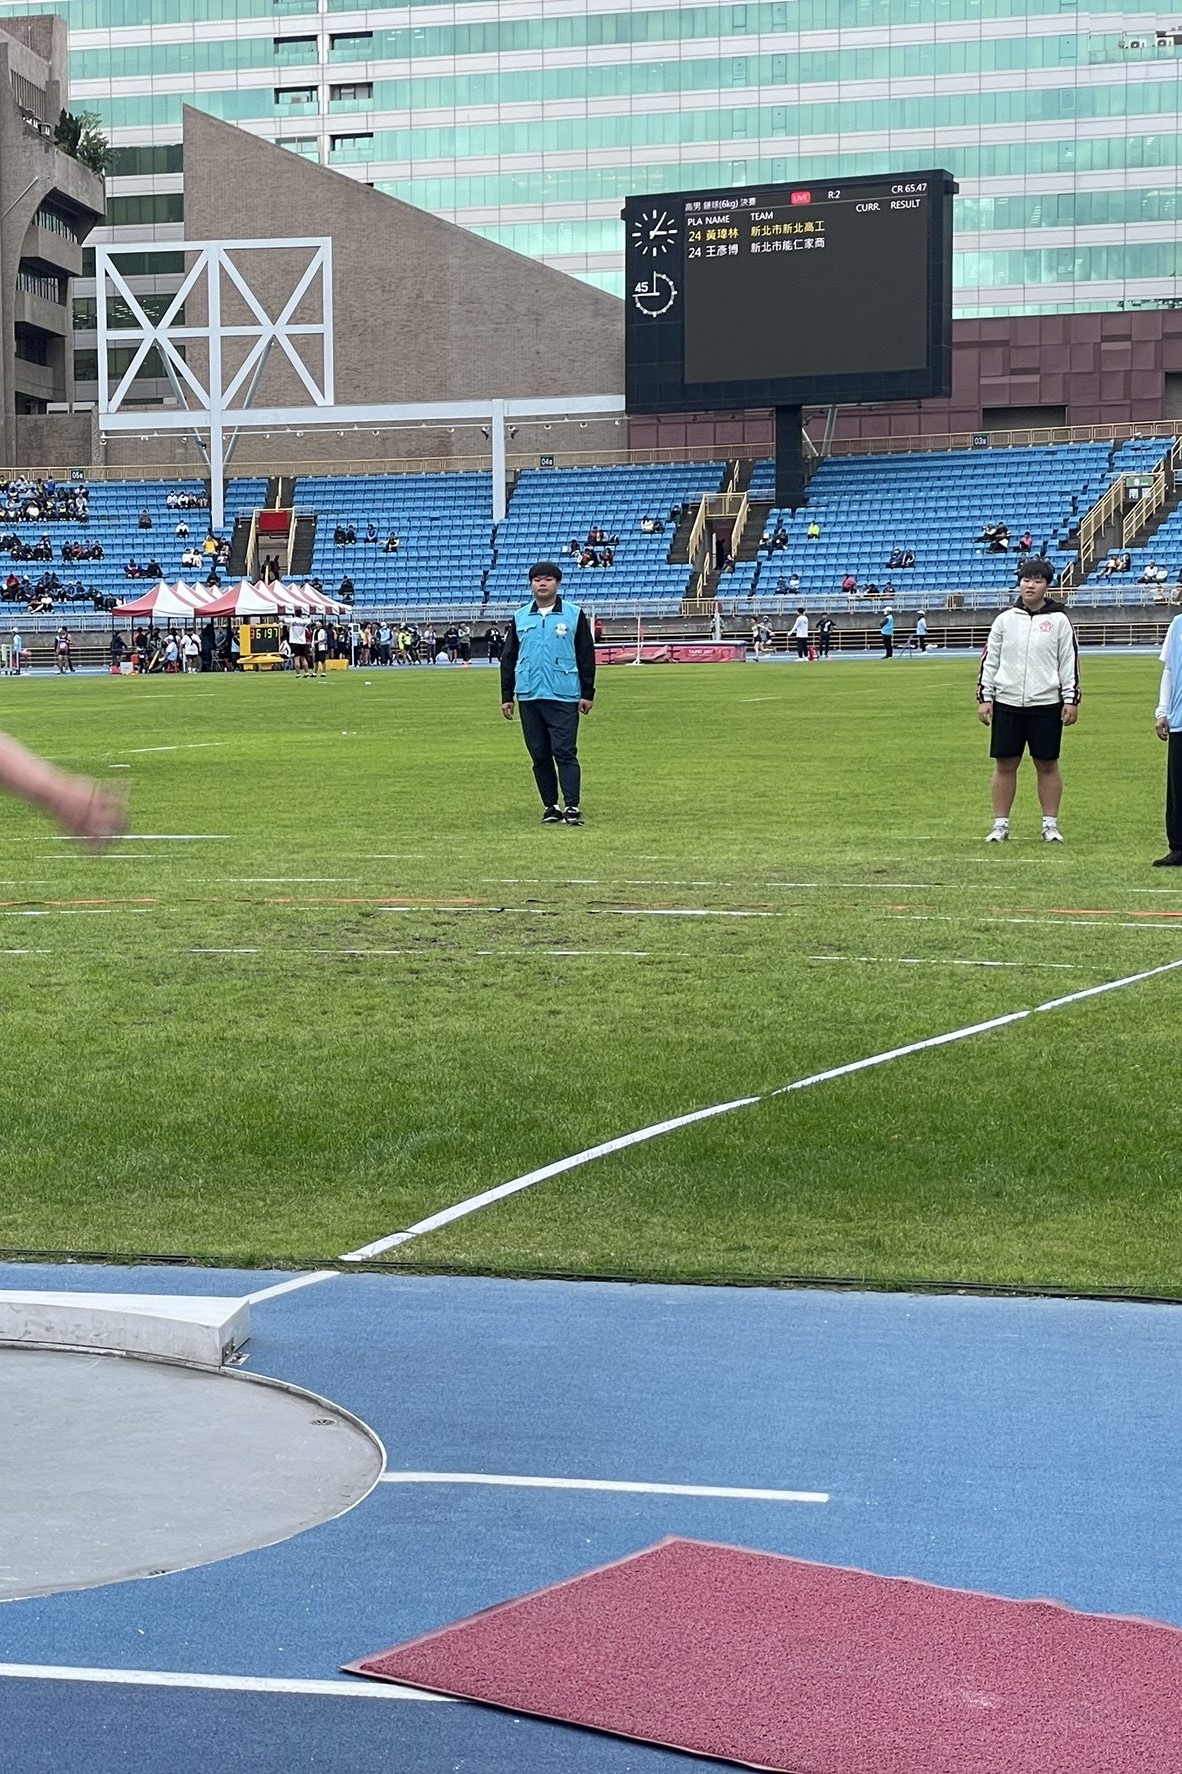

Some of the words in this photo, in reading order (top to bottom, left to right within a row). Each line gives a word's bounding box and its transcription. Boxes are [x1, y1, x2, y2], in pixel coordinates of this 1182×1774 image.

[891, 185, 903, 194] CR
[905, 183, 927, 193] 65.47
[740, 197, 756, 207] 決賽
[793, 193, 808, 202] LIVE
[687, 217, 703, 226] PLA
[705, 214, 730, 224] NAME
[750, 211, 774, 221] TEAM
[855, 202, 881, 212] CURR.
[890, 199, 921, 209] RESULT
[688, 231, 702, 242] 24
[750, 220, 825, 237] 新北市新北高工
[688, 247, 702, 258] 24
[750, 237, 825, 253] 新北市能仁家商
[634, 281, 649, 292] 45
